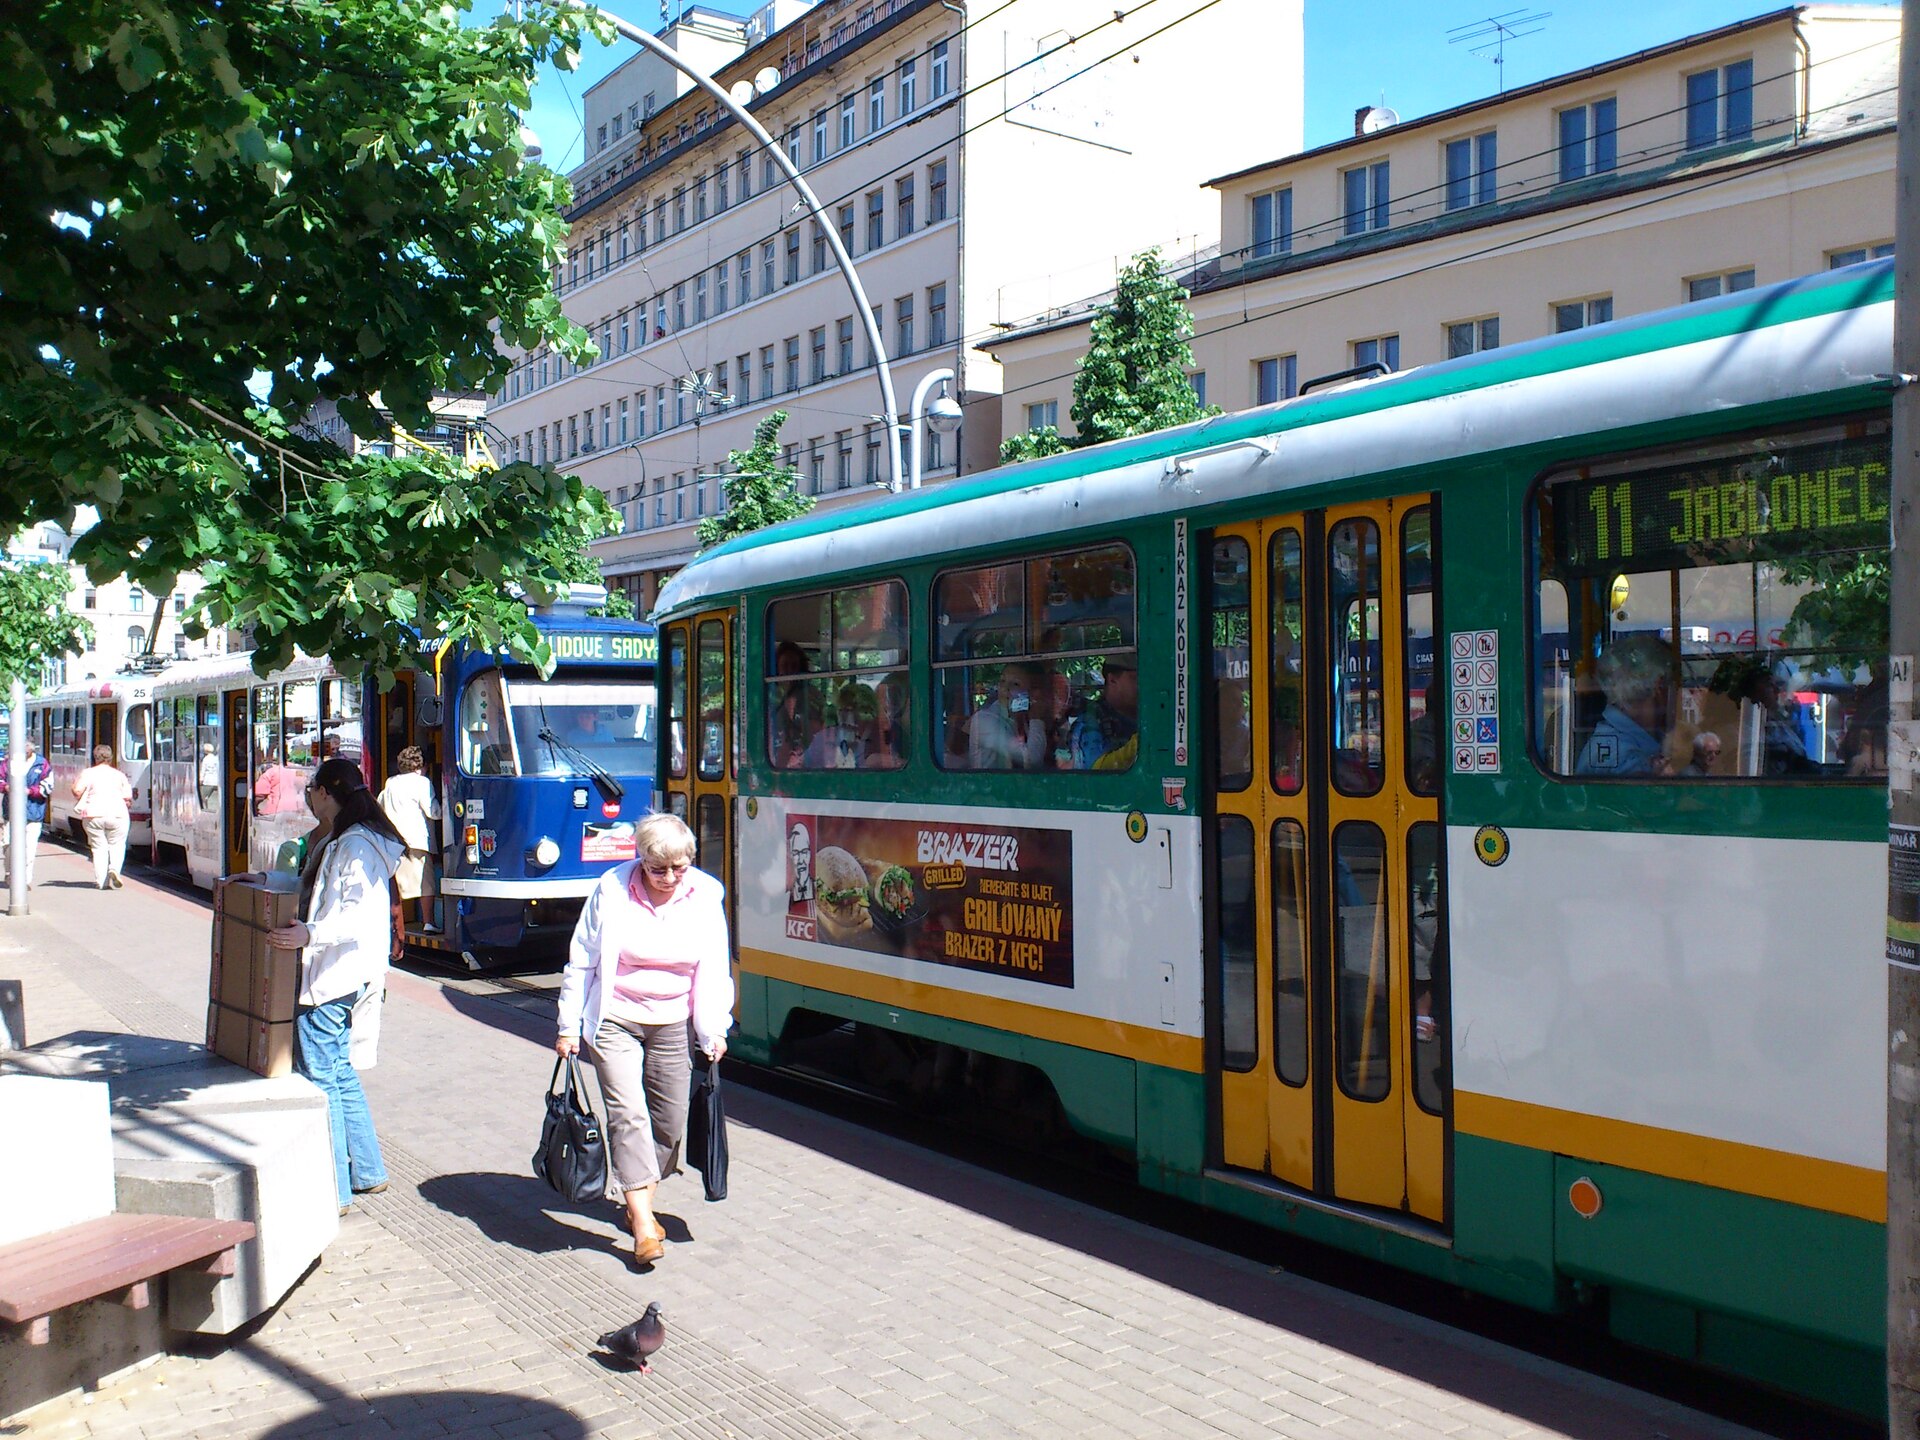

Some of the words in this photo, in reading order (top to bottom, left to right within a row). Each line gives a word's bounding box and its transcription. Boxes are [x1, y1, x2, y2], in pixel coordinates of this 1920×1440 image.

[1589, 481, 1634, 559] 11
[1177, 522, 1185, 609] ZÁKAZ
[550, 637, 603, 658] LIDOVE
[134, 688, 146, 698] 25
[1177, 618, 1186, 743] KOUŘENÍ
[917, 831, 1019, 871] BRAZER
[925, 867, 964, 884] GRILLED
[1020, 883, 1030, 899] SI
[1031, 884, 1053, 901] UJET
[787, 919, 814, 940] KFC
[964, 896, 1063, 942] GRILOVANÝ
[945, 931, 995, 964] BRAZER
[998, 939, 1008, 965] Z
[1011, 942, 1043, 972] KFC!
